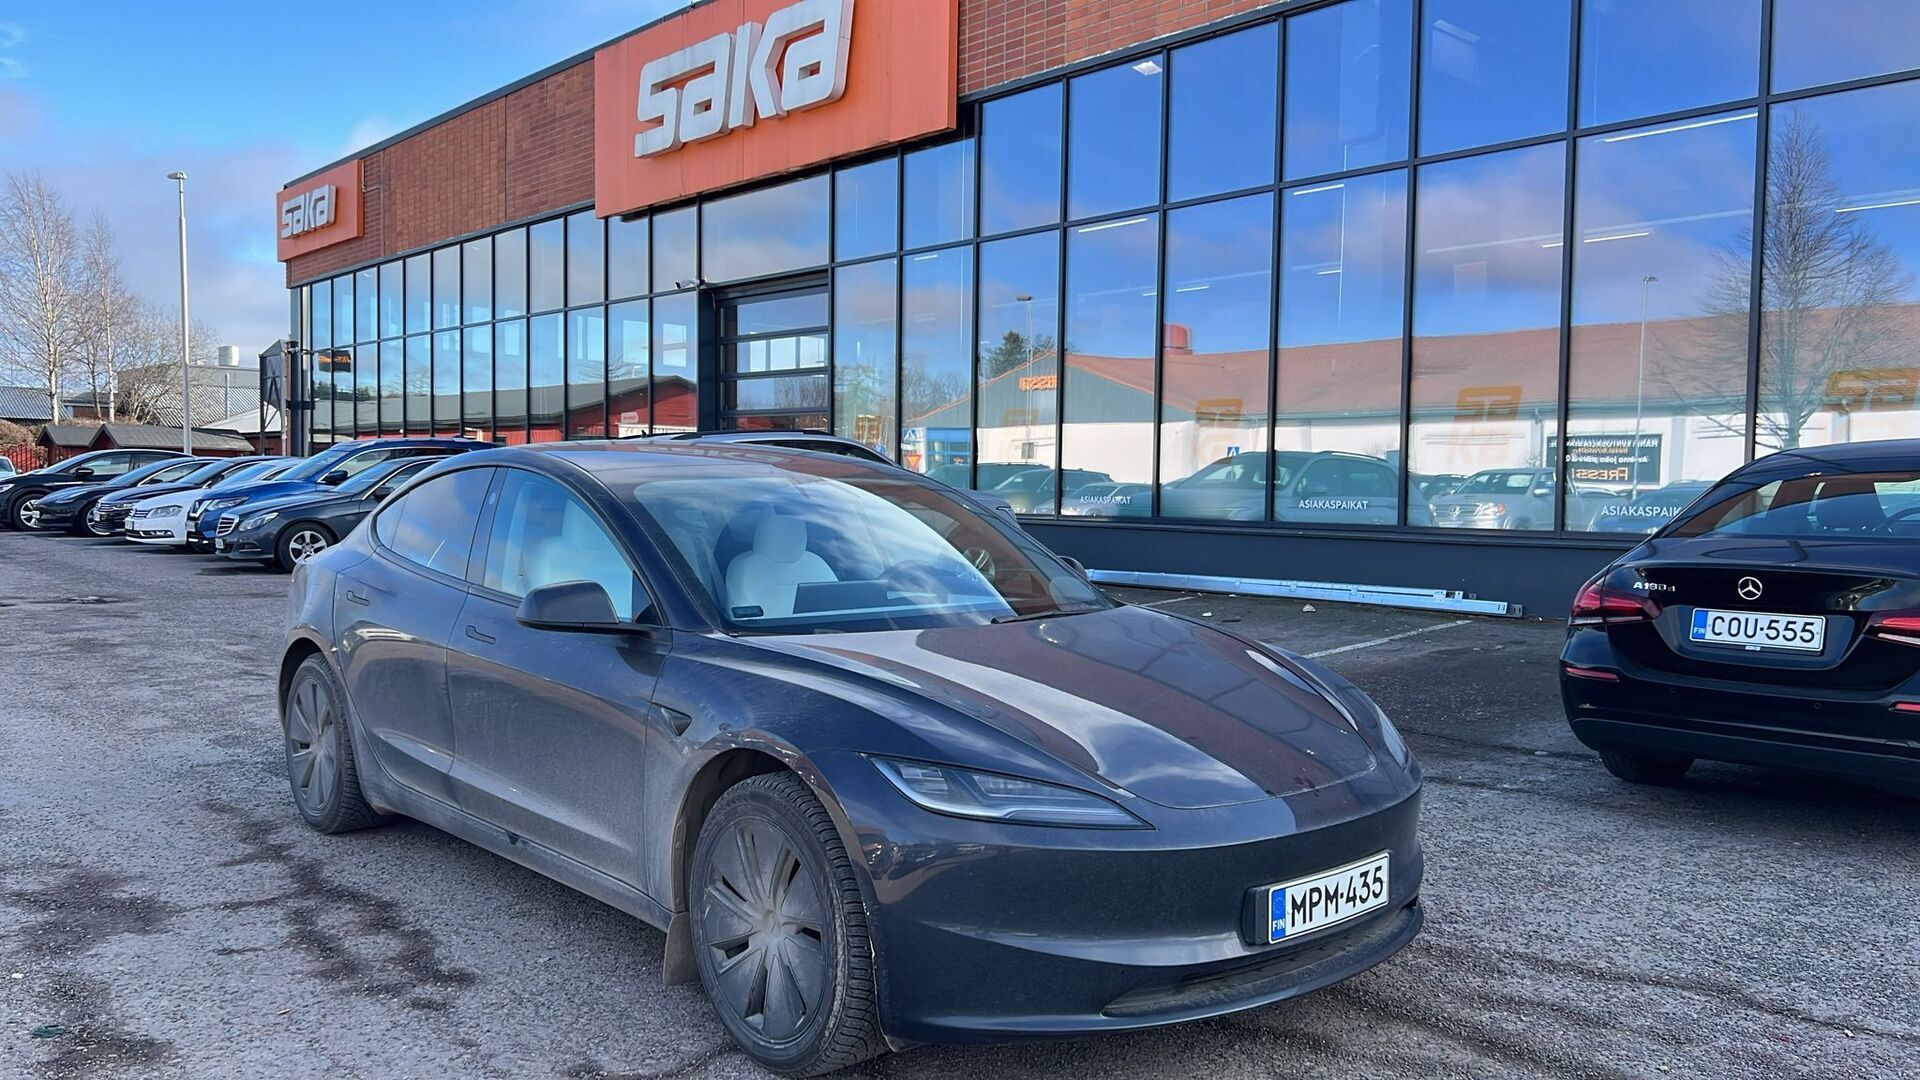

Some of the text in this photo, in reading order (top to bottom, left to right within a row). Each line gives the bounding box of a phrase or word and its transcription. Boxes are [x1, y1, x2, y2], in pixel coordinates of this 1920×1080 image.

[1298, 499, 1369, 510] ASIAKASPAIKAT
[1693, 626, 1706, 635] FIN
[1711, 615, 1816, 644] COU-555
[1291, 865, 1384, 928] MPM-435
[1272, 918, 1286, 932] FIN
